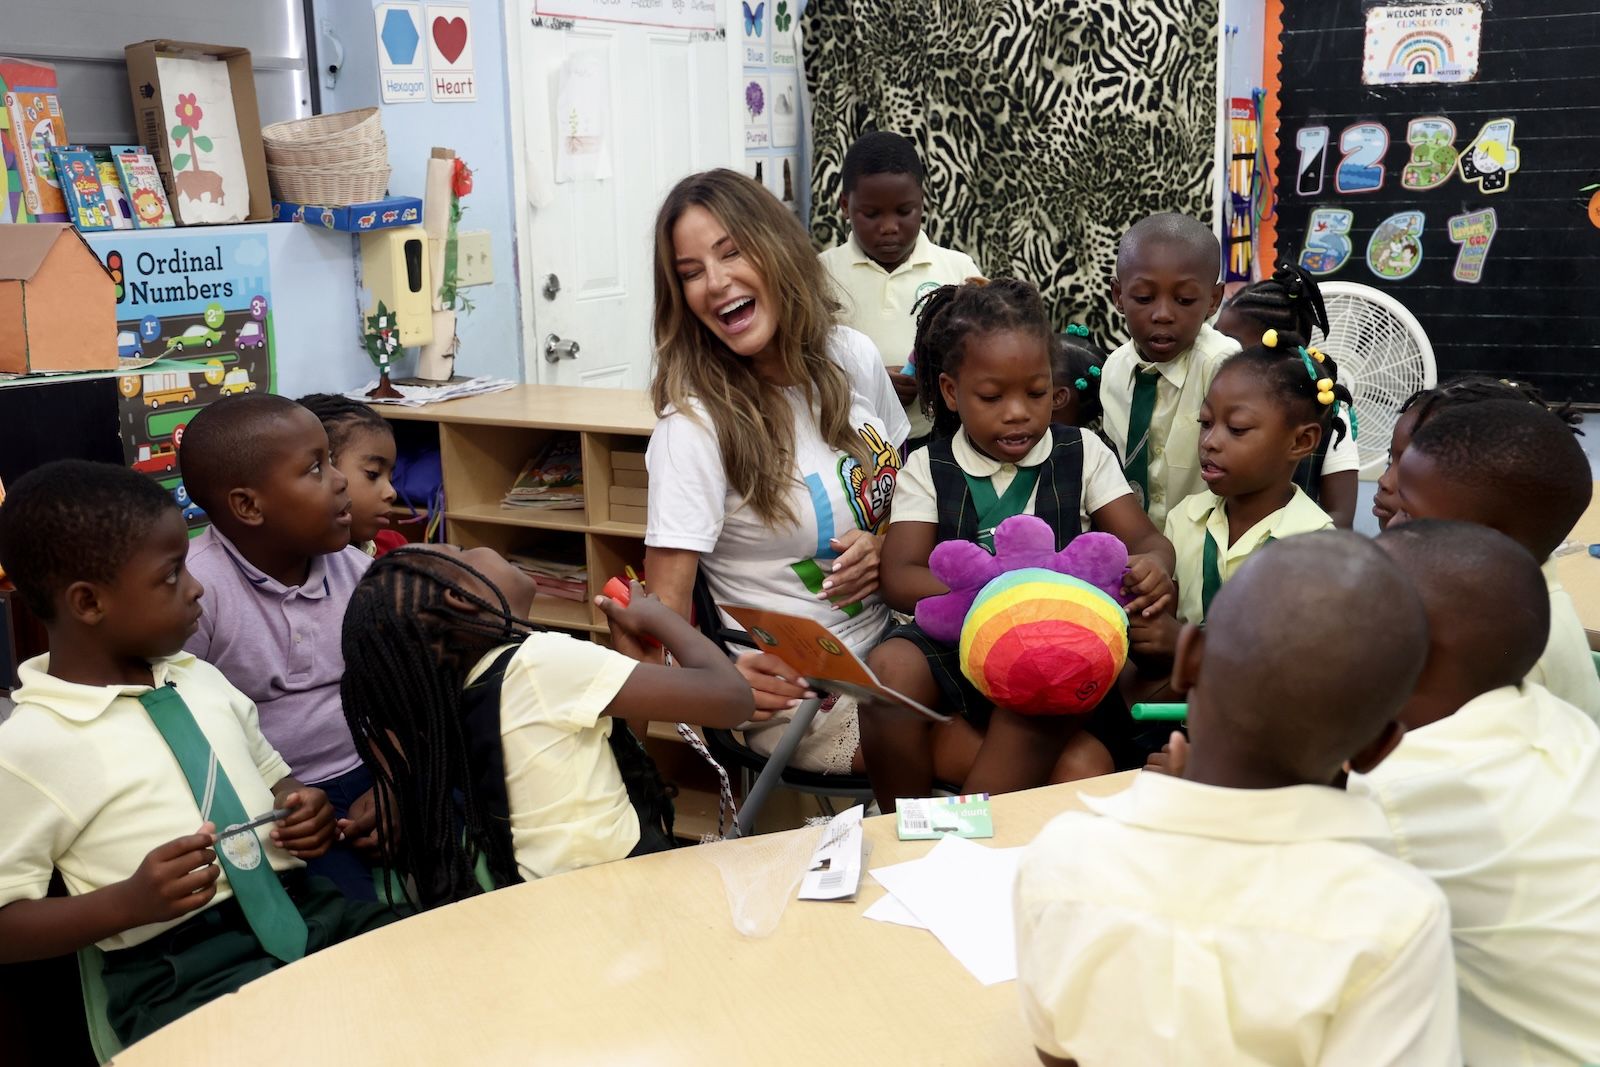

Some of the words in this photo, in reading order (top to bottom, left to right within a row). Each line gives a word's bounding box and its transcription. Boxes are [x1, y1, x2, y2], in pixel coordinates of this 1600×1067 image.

[1386, 9, 1427, 18] WELCOME
[1431, 8, 1442, 16] TO
[1445, 7, 1464, 16] OUR
[747, 48, 764, 62] Blue
[773, 51, 795, 64] Green
[386, 80, 424, 96] Hexagon
[436, 78, 472, 95] Heart
[746, 131, 768, 147] Purple
[1469, 235, 1487, 246] GOD
[137, 246, 224, 276] Ordinal
[130, 276, 233, 305] Numbers
[207, 308, 223, 322] 2nd
[252, 300, 266, 316] 3rd
[144, 320, 157, 335] 1st
[123, 376, 138, 393] 5th
